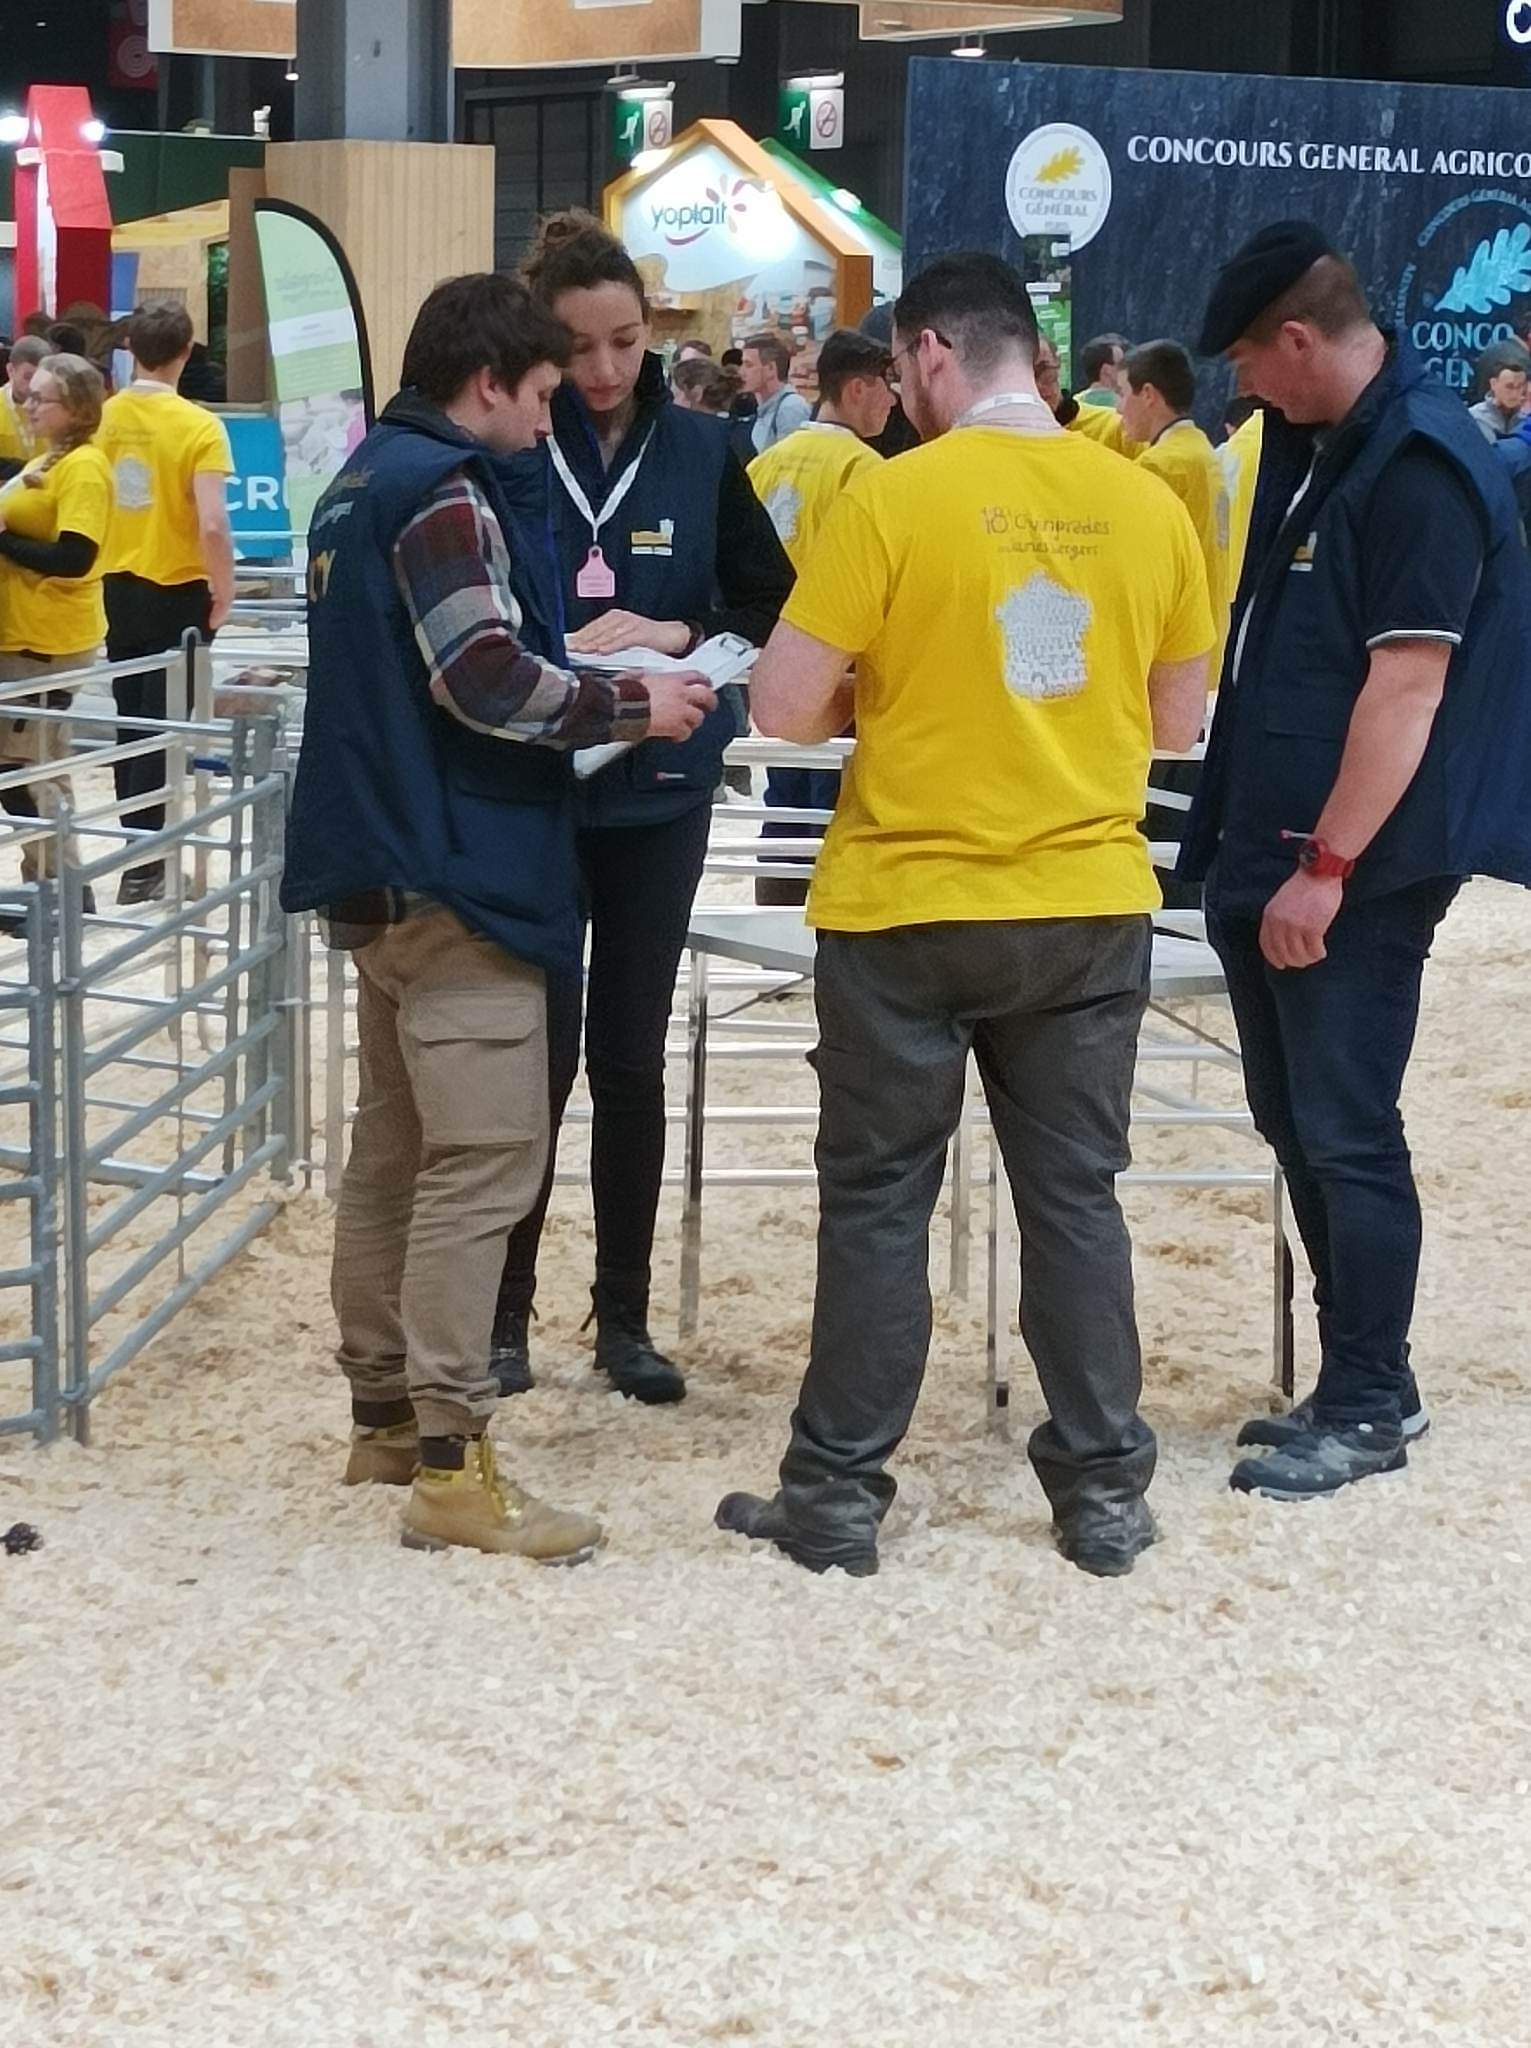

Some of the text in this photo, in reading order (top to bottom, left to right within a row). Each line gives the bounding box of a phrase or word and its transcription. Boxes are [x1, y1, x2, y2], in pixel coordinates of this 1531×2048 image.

[1127, 135, 1531, 178] CONCOURS GENERAL AGRICO
[1019, 187, 1098, 201] CONCOURS
[651, 201, 728, 231] yoplait
[224, 475, 288, 511] CR
